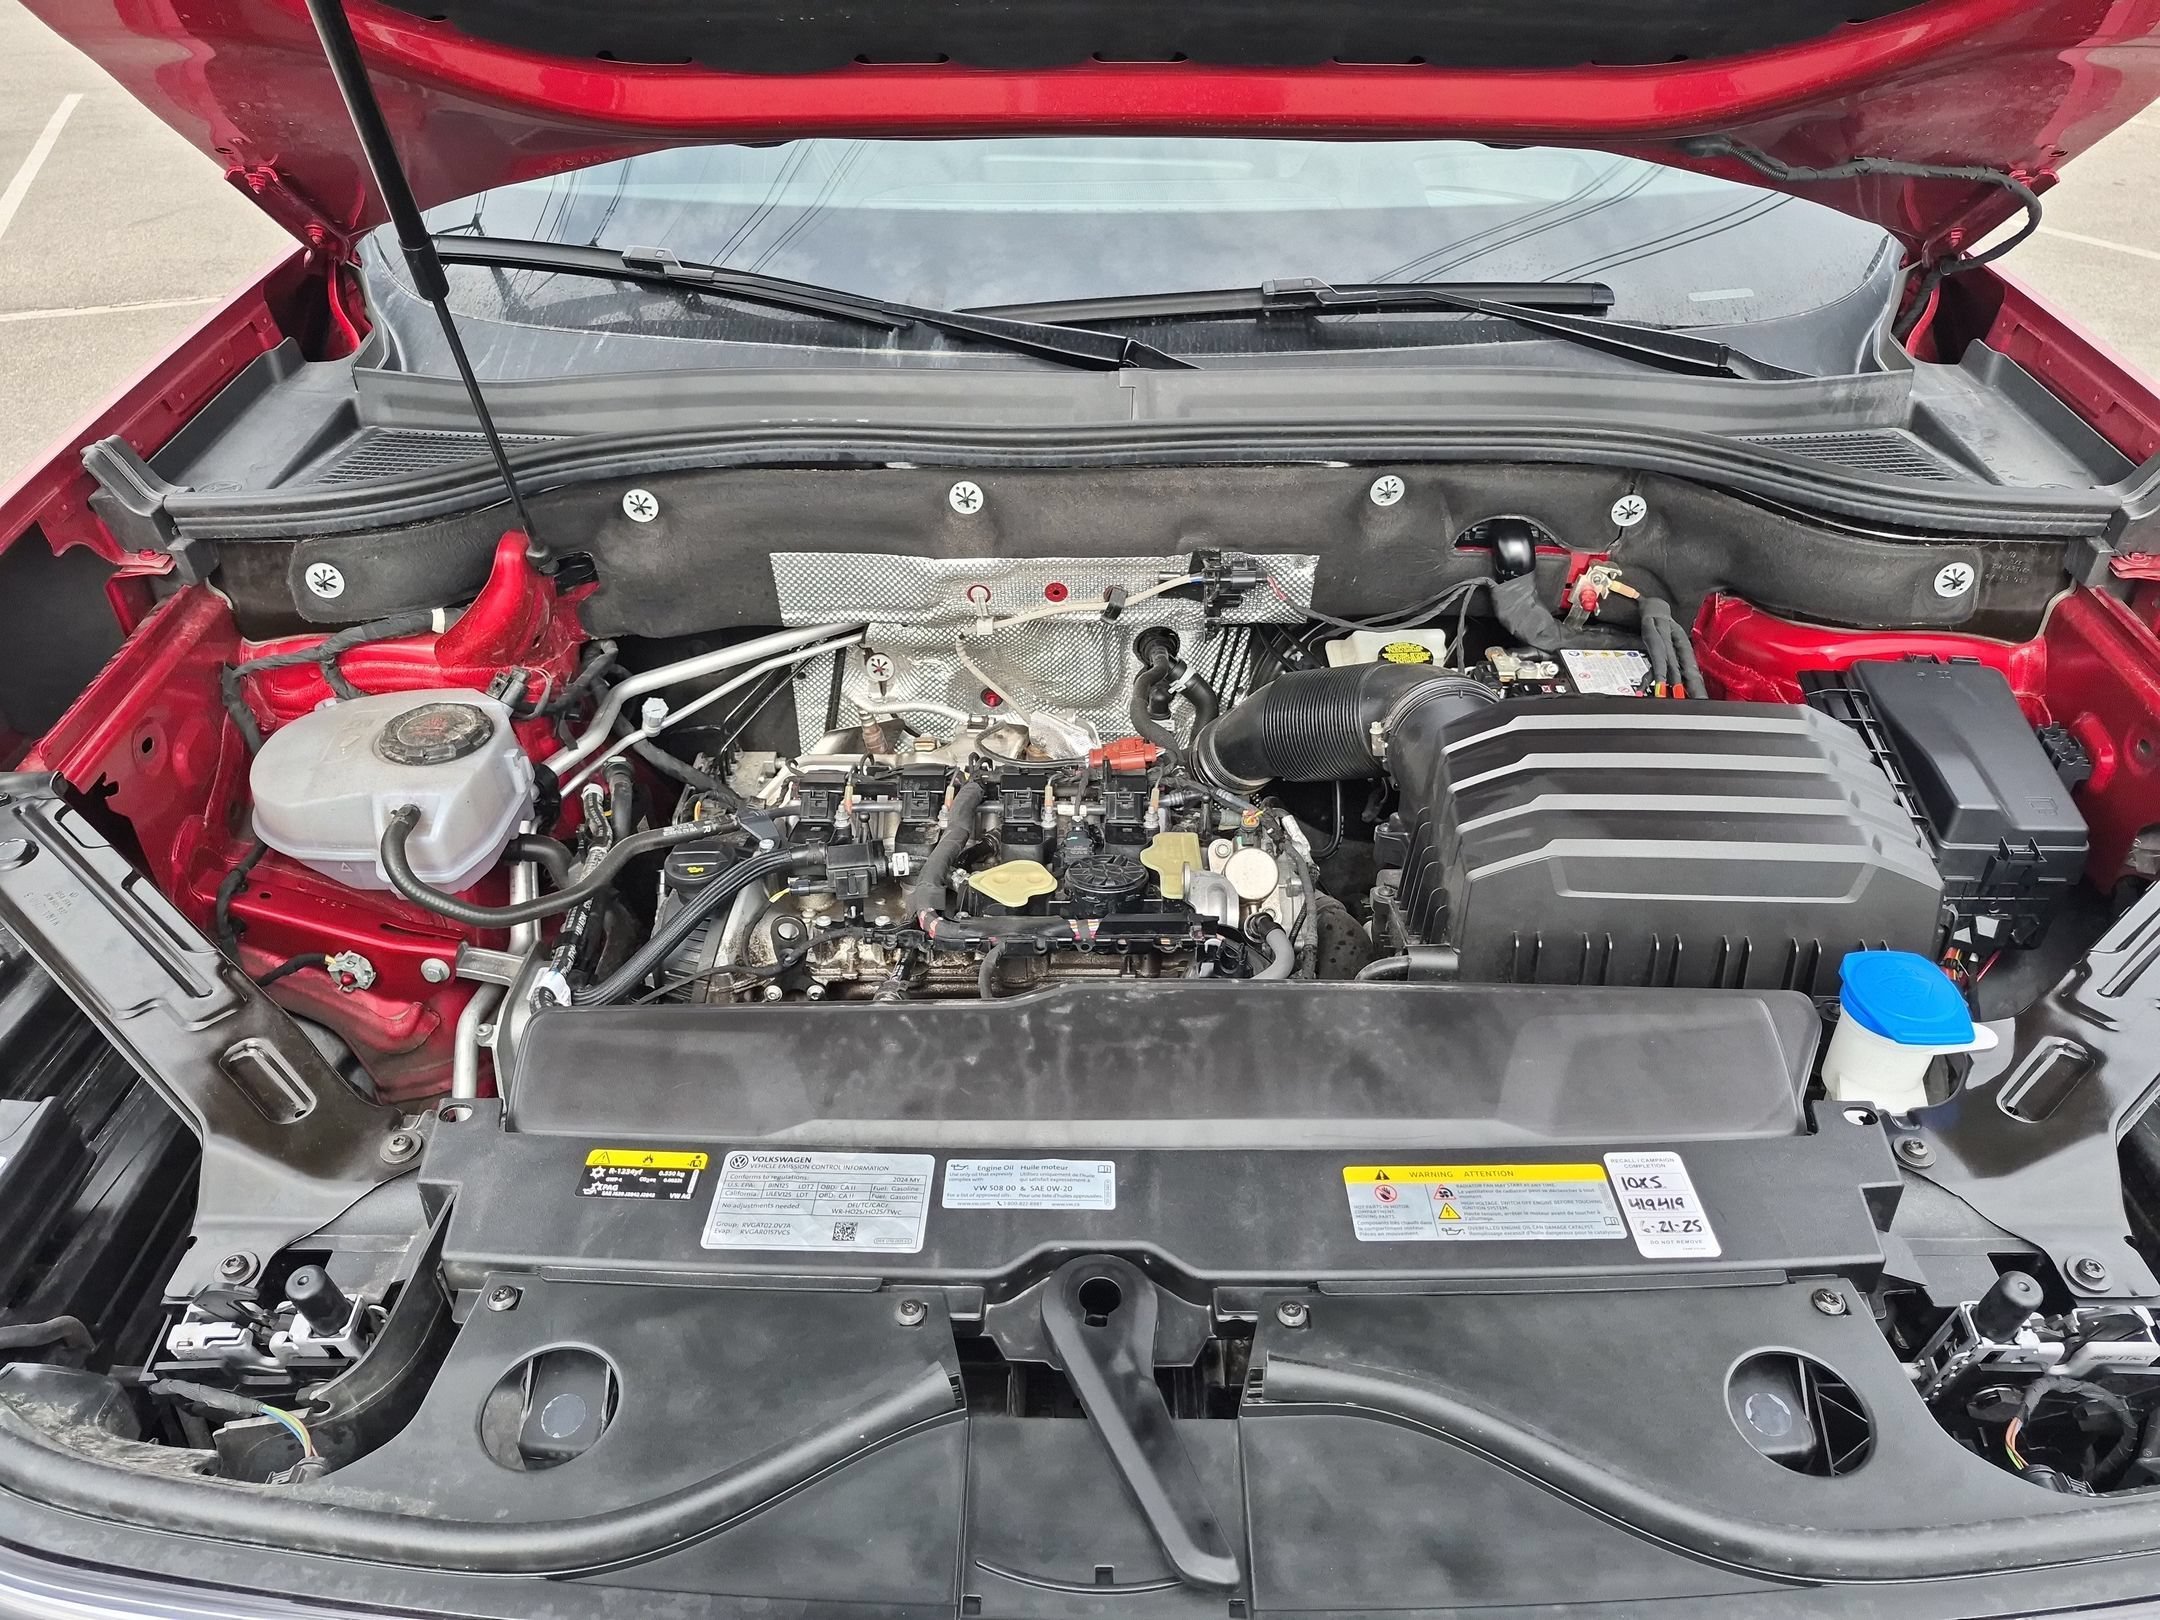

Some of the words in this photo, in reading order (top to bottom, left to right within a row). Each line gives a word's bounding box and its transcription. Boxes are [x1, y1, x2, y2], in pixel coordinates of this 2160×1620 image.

[752, 1156, 812, 1164] VOLKSWAGEN
[608, 1168, 644, 1177] R-1234yf
[1464, 1170, 1514, 1178] ATTENTION
[733, 1202, 774, 1210] adjustments
